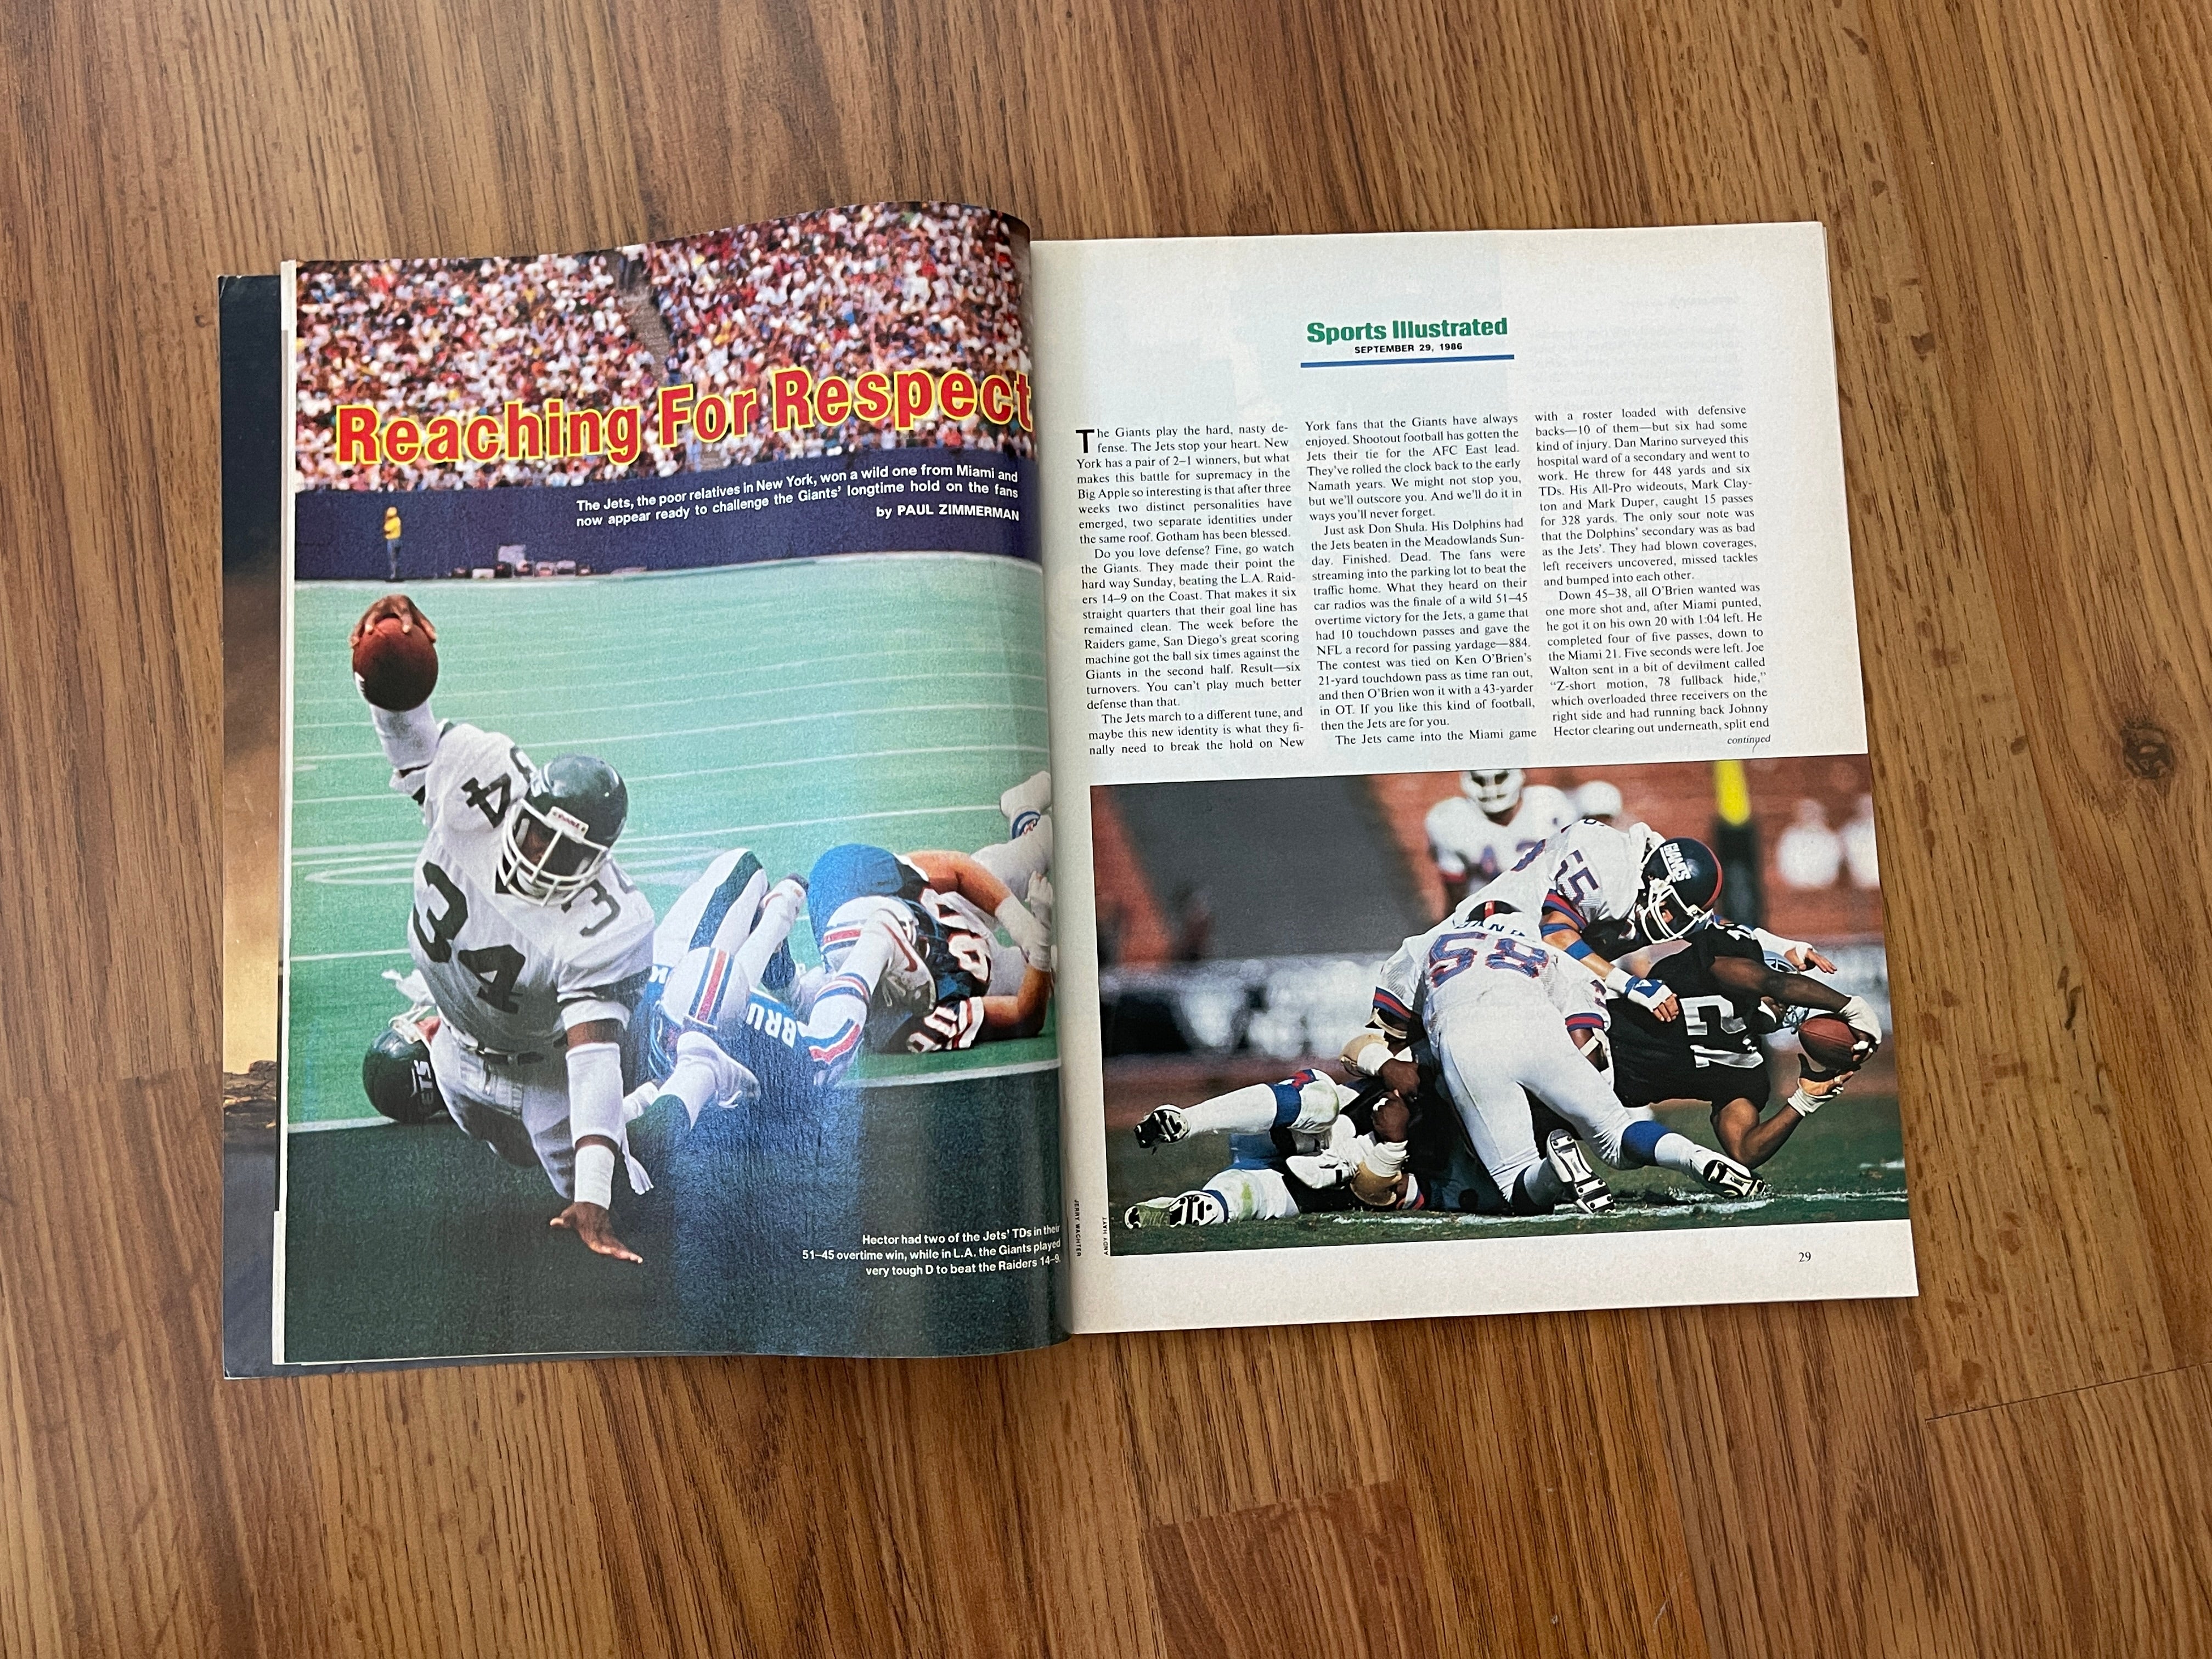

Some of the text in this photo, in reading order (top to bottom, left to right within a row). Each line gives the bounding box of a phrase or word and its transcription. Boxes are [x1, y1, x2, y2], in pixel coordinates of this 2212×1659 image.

[1307, 317, 1508, 346] Sports Illustrated
[1355, 342, 1463, 354] SEPTEMBER 29, 1986
[336, 368, 1033, 465] Reaching For Respect
[1534, 411, 1558, 421] with
[1583, 411, 1613, 420] roster
[1622, 407, 1656, 418] loaded
[1665, 406, 1689, 416] with
[1698, 405, 1746, 415] defensive
[1115, 427, 1150, 437] Giants
[1156, 426, 1178, 438] play
[1183, 425, 1200, 436] the
[1206, 424, 1233, 435] hard,
[1239, 425, 1266, 435] nasty
[1272, 422, 1288, 433] de-
[1305, 414, 1518, 431] York fans that the Giants have always
[576, 464, 1018, 511] The Jets, the poor relatives in New York, won a wild one from Miami and
[577, 479, 1018, 527] now appear ready to challenge the Giants’ longtime hold on the fans
[876, 504, 1019, 521] by PAUL ZIMMERMAN
[1094, 542, 1294, 560] Do you love defense? Fine, go watch
[1334, 600, 1366, 610] radios
[1393, 597, 1409, 607] the
[1413, 596, 1442, 607] finale
[1445, 595, 1458, 606] of
[1469, 594, 1492, 604] wild
[1496, 592, 1528, 603] 51–45
[1559, 590, 1591, 601] Down
[1595, 588, 1631, 599] 45–38,
[1635, 586, 1647, 597] all
[1651, 585, 1694, 596] O’Brien
[1698, 583, 1736, 594] wanted
[1085, 634, 1300, 650] Raiders game, San Diego’s great scoring
[1554, 717, 1770, 736] Hector clearing out underneath, split end
[1334, 729, 1537, 745] The Jets came into the Miami game
[1727, 734, 1771, 746] continued
[1089, 744, 1115, 756] nally
[1121, 743, 1147, 753] need
[1153, 744, 1164, 752] to
[1170, 741, 1200, 752] break
[1206, 740, 1223, 750] the
[1229, 738, 1253, 749] hold
[1279, 737, 1304, 747] New
[413, 861, 525, 1013] 34
[1429, 932, 1549, 988] 58
[862, 1224, 1060, 1245] Hector had two of the Jets’ TDs in their
[802, 1239, 1060, 1262] 51–45 overtime win, while in L.A. the Giants played
[1798, 1251, 1812, 1262] 29
[866, 1253, 1061, 1278] very tough D to beat the Raiders 14–9.
